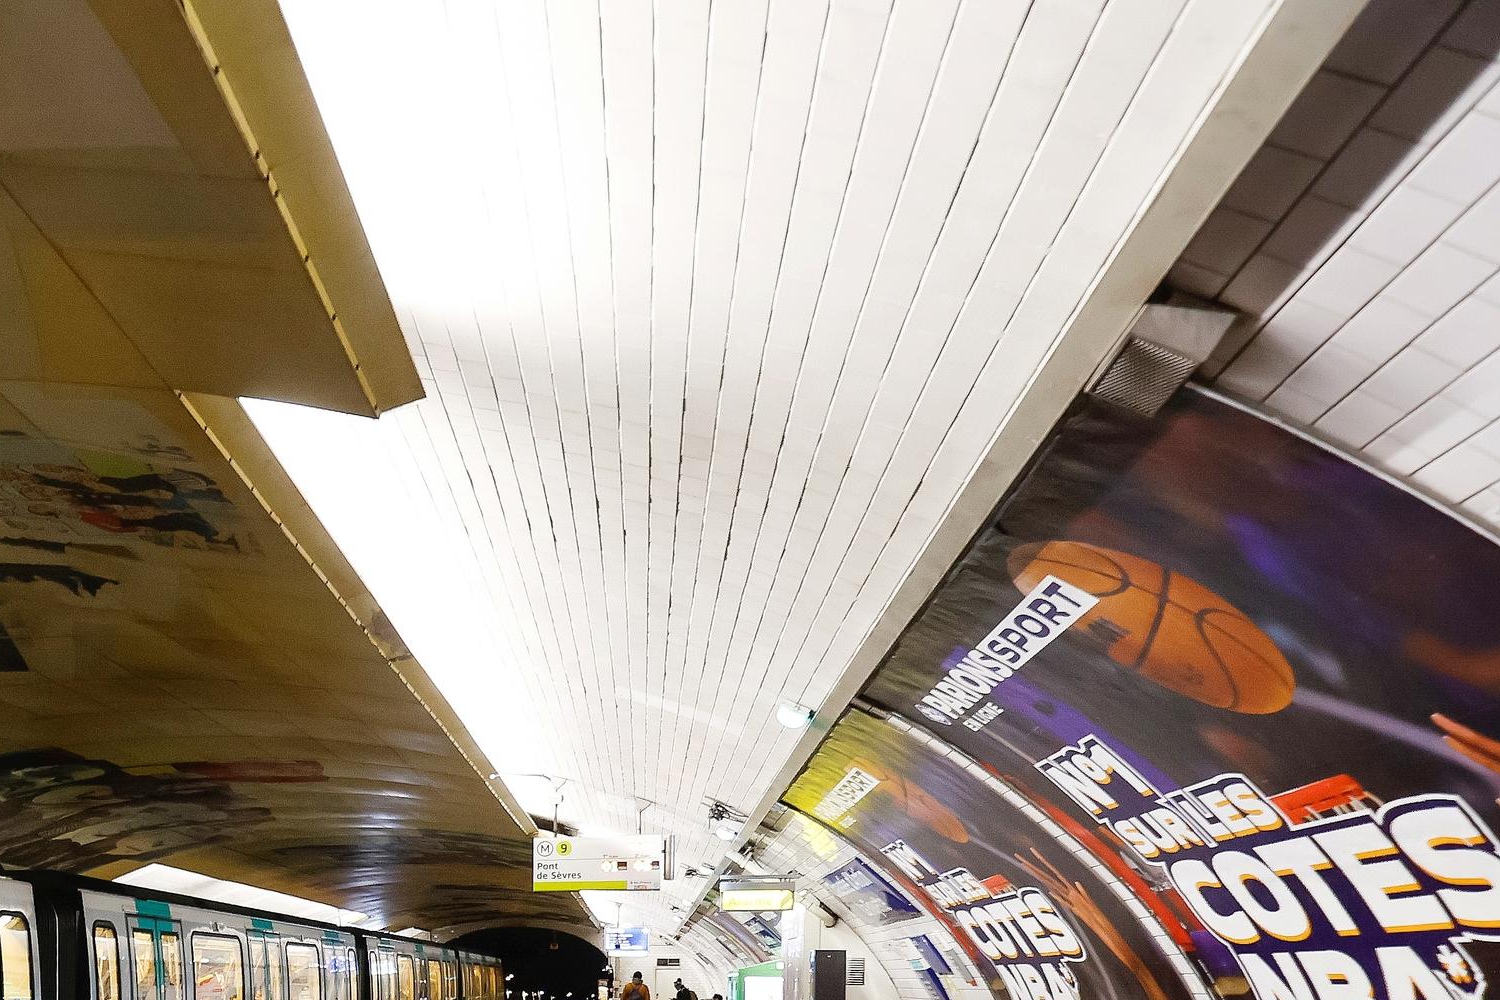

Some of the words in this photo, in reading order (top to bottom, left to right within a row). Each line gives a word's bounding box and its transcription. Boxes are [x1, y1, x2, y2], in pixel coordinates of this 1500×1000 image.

[920, 649, 1014, 720] PARIONS
[987, 581, 1082, 664] SPORT
[560, 843, 568, 853] 9
[1114, 807, 1205, 858] SUR
[1179, 782, 1283, 842] LES
[536, 871, 548, 880] de
[551, 871, 582, 880] Sèvres
[537, 862, 559, 871] Pont
[1169, 806, 1500, 944] COTES
[956, 892, 1082, 960] COTES
